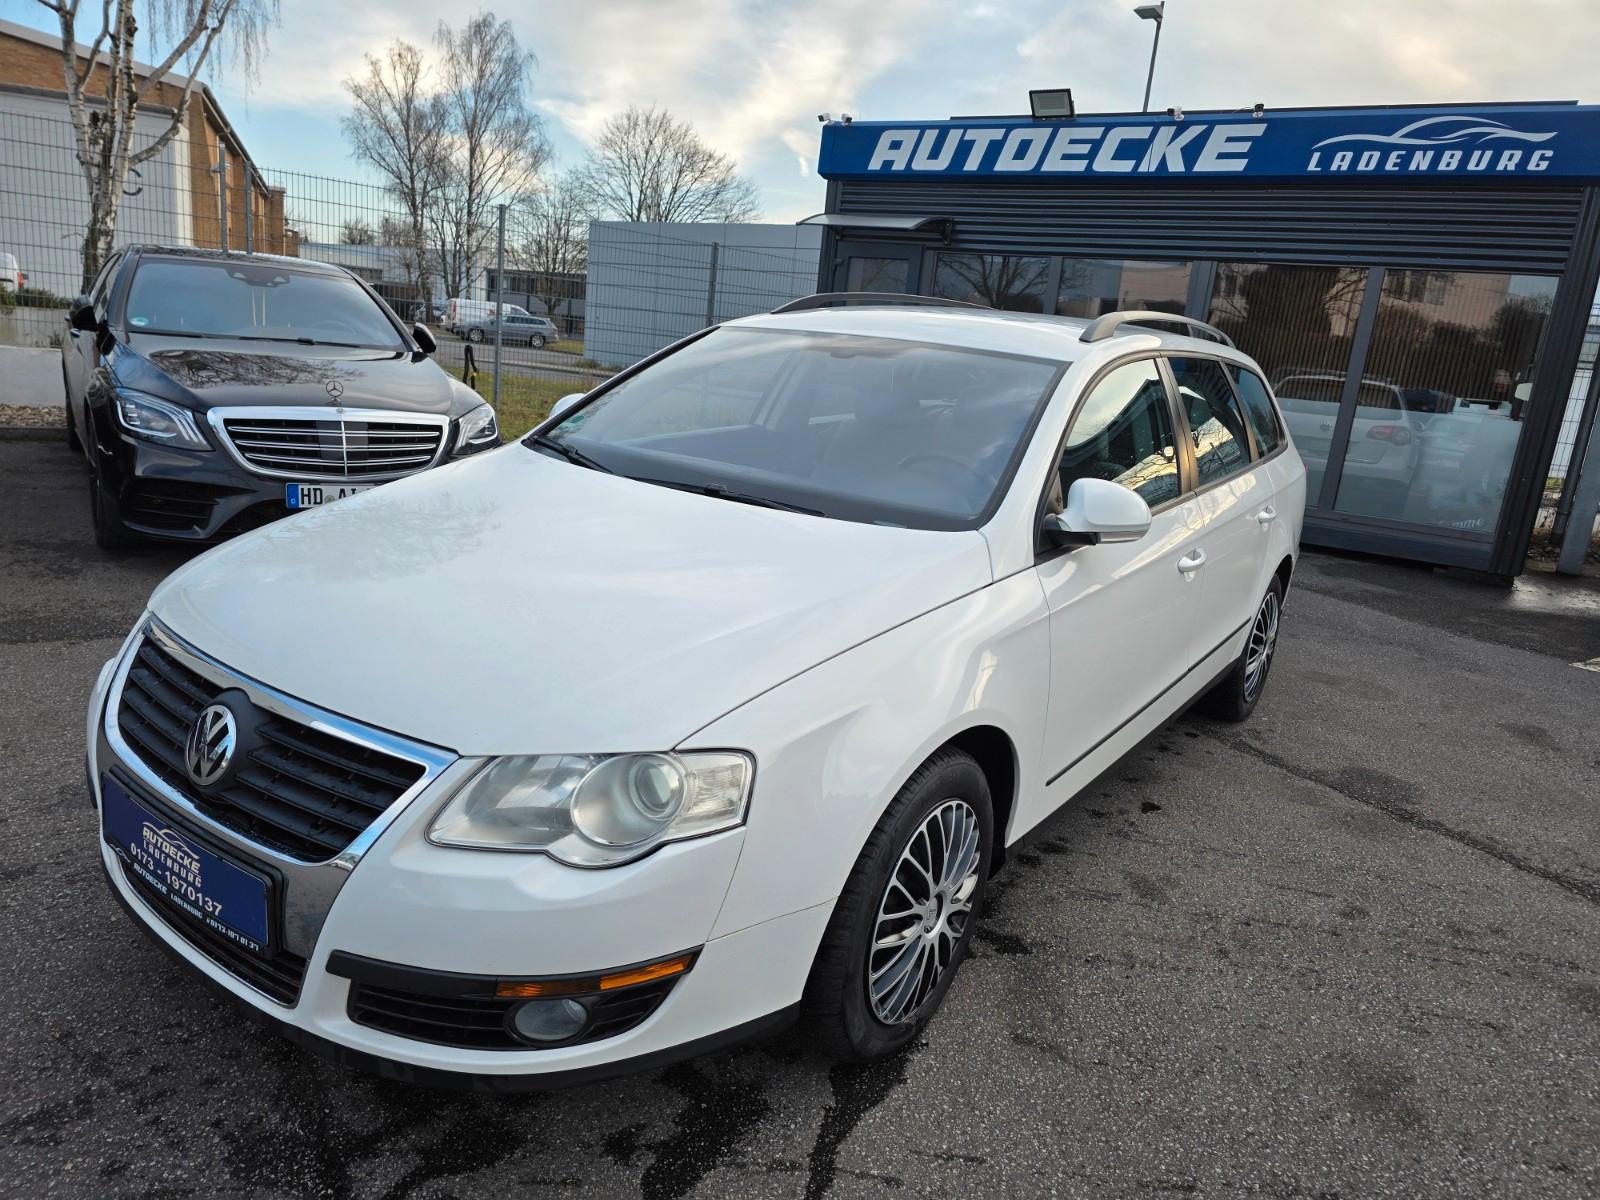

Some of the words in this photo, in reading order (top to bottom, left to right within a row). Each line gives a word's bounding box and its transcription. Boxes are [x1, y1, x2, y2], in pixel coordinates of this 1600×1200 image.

[867, 123, 1268, 172] AUTOECKE
[1306, 149, 1555, 172] LADENBURG
[300, 487, 323, 505] HD
[142, 826, 201, 874] AUTOECKE
[143, 839, 202, 888] LADENBURG
[130, 842, 154, 870] 0173
[164, 870, 222, 917] 1970137
[133, 862, 168, 895] AUTOECKE
